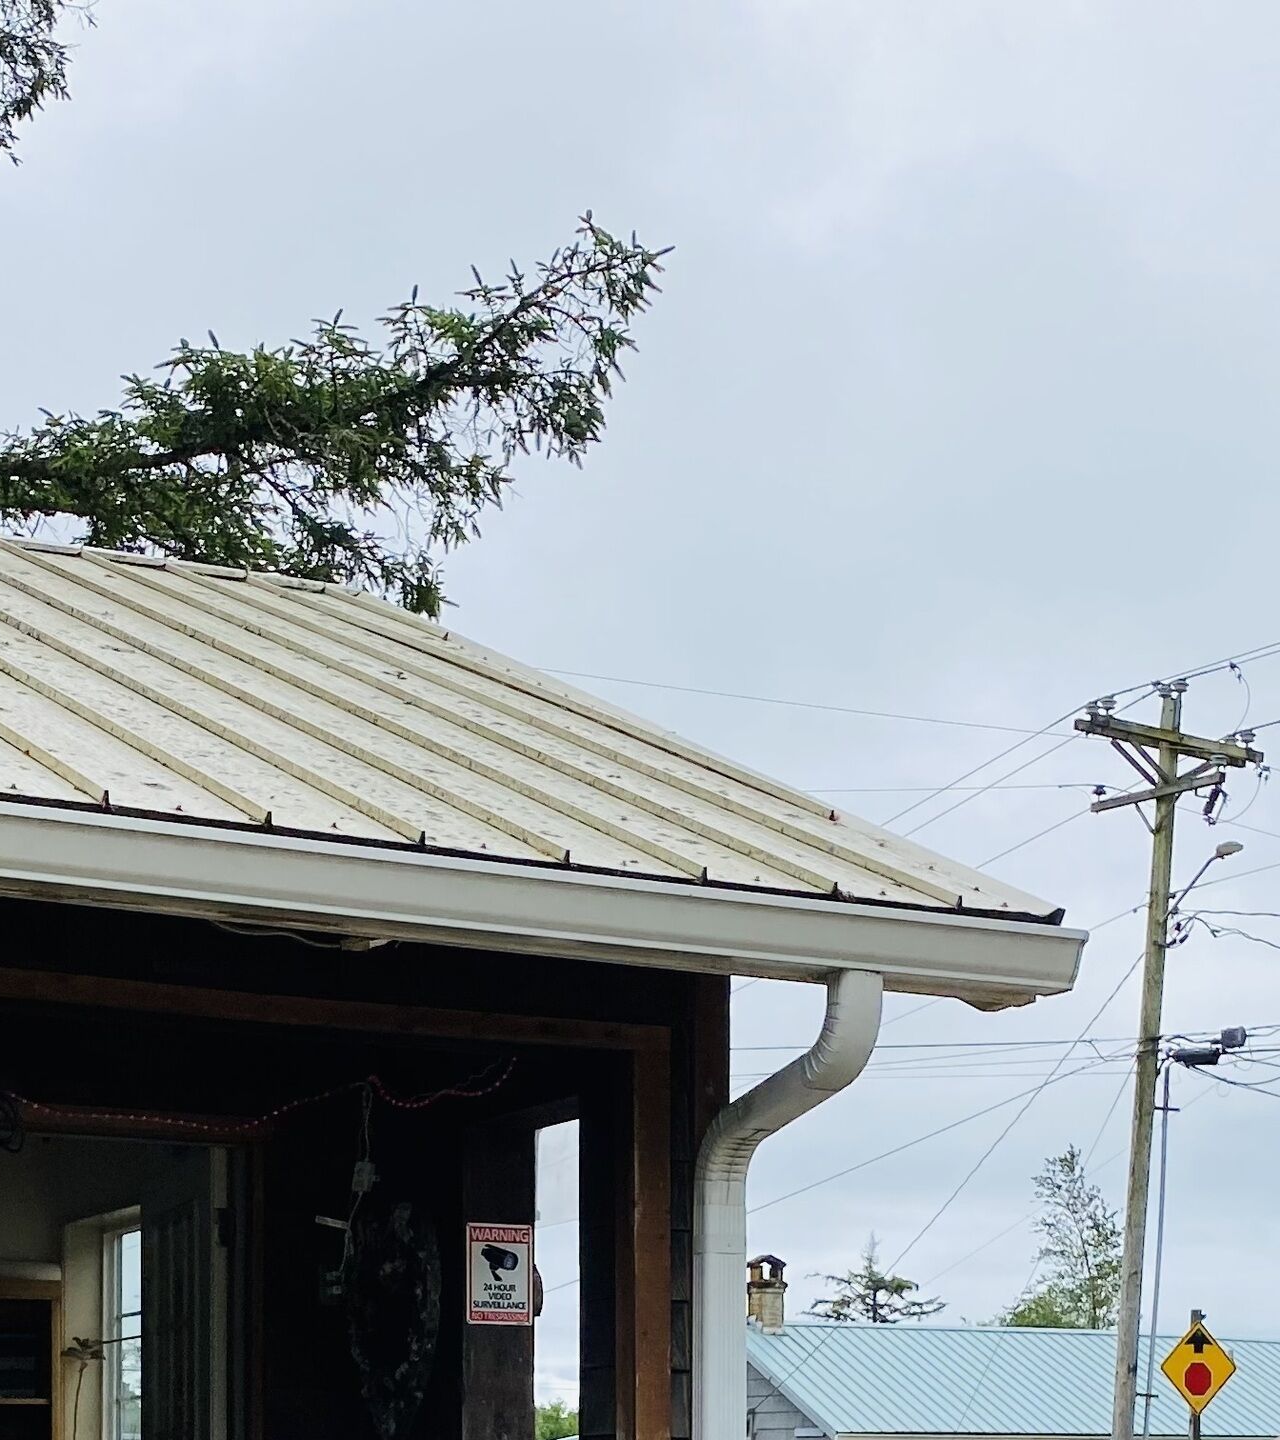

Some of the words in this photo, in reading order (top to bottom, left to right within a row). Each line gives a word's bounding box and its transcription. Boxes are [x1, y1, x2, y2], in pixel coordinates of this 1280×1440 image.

[471, 1227, 529, 1242] WARNING
[483, 1283, 492, 1292] 24
[494, 1284, 516, 1292] HOUR
[488, 1292, 512, 1300] VIDEO
[473, 1300, 526, 1310] SURVEILLANCE
[472, 1312, 483, 1320] NO
